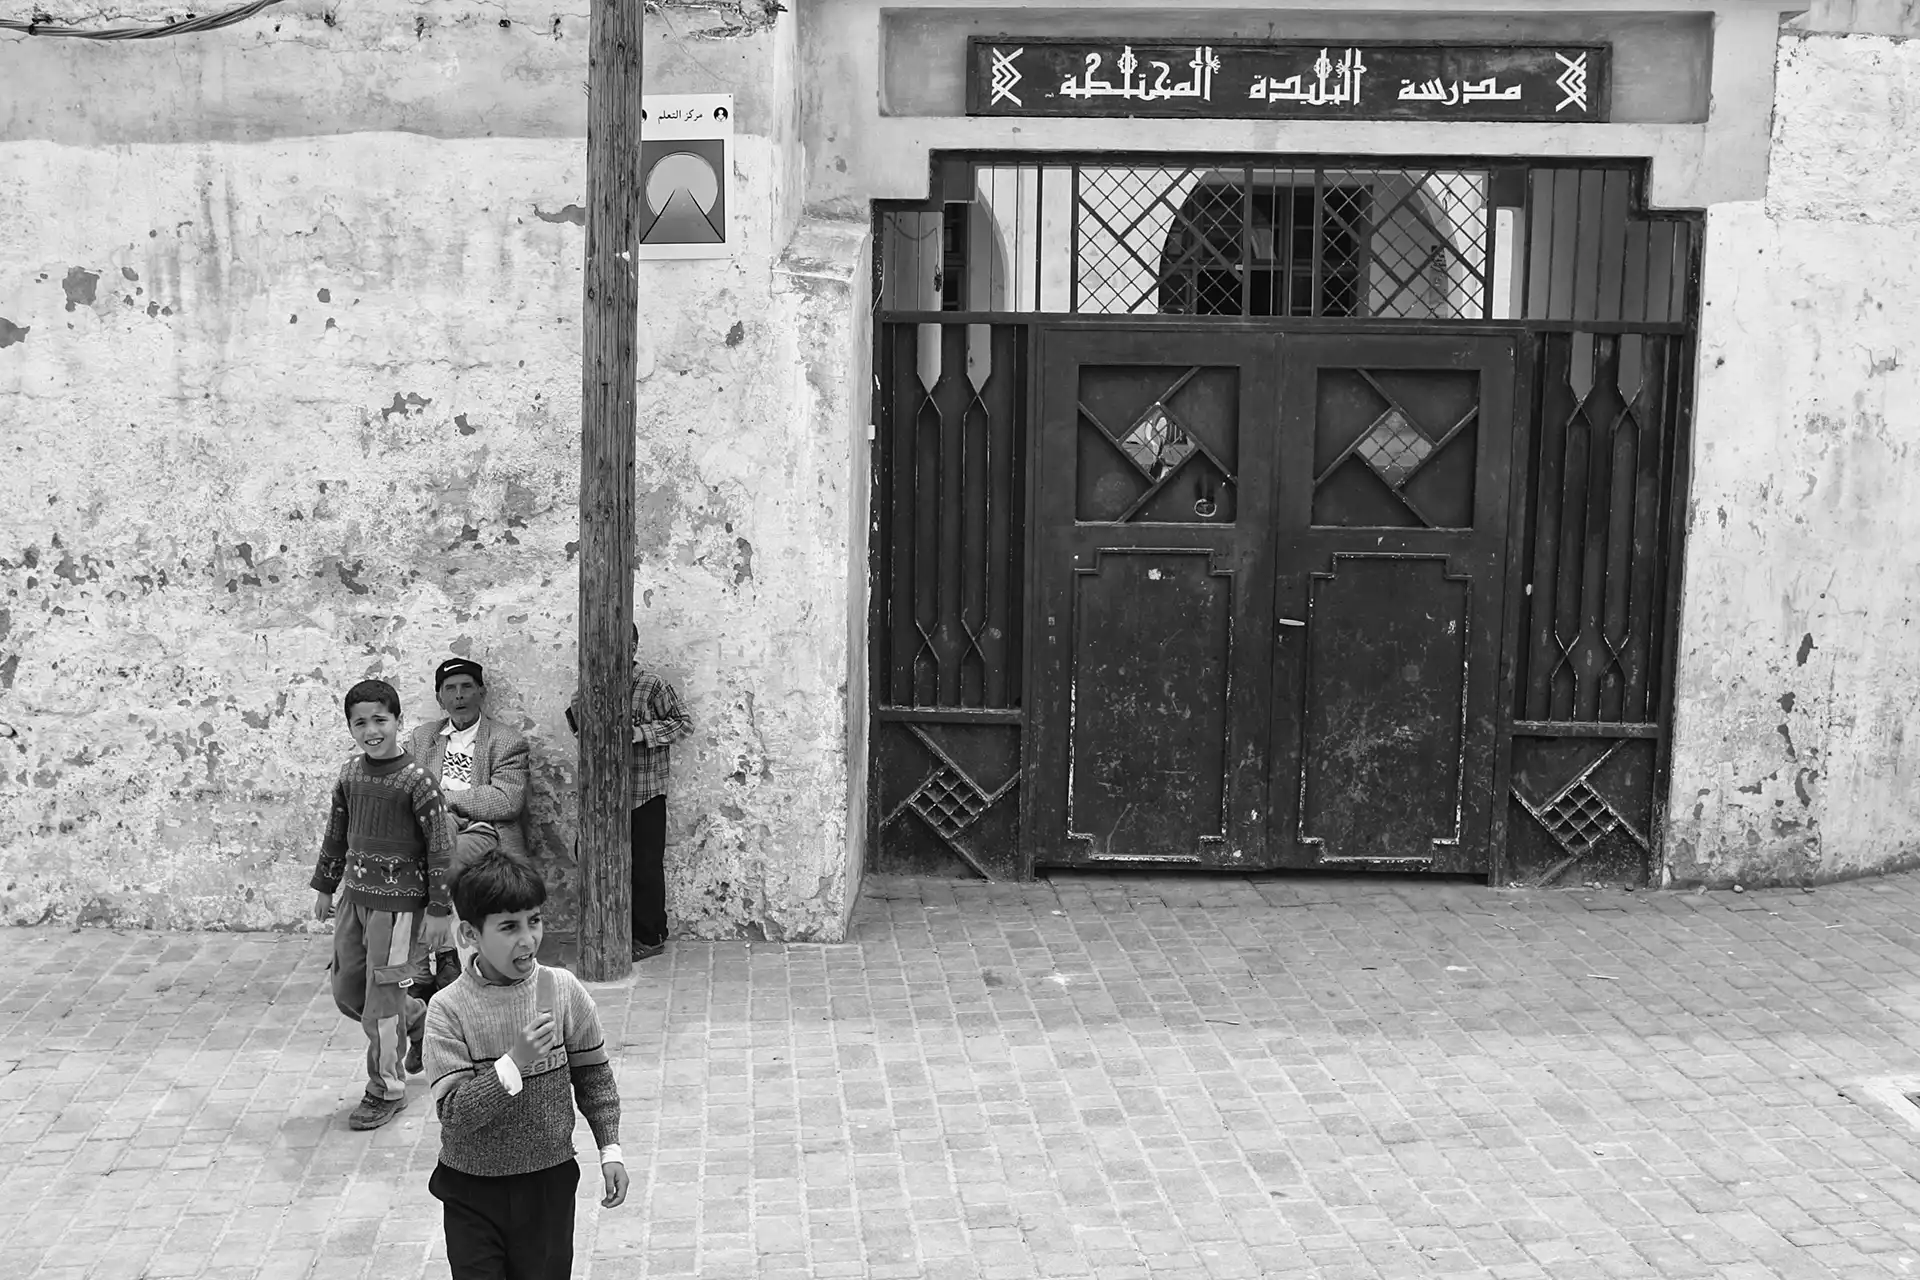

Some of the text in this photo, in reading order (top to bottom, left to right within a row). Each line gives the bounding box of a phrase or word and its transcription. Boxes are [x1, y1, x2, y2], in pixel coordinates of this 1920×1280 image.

[1059, 45, 1522, 106] مدرسة البليدة المختلطة
[657, 109, 703, 124] مركز التعلم
